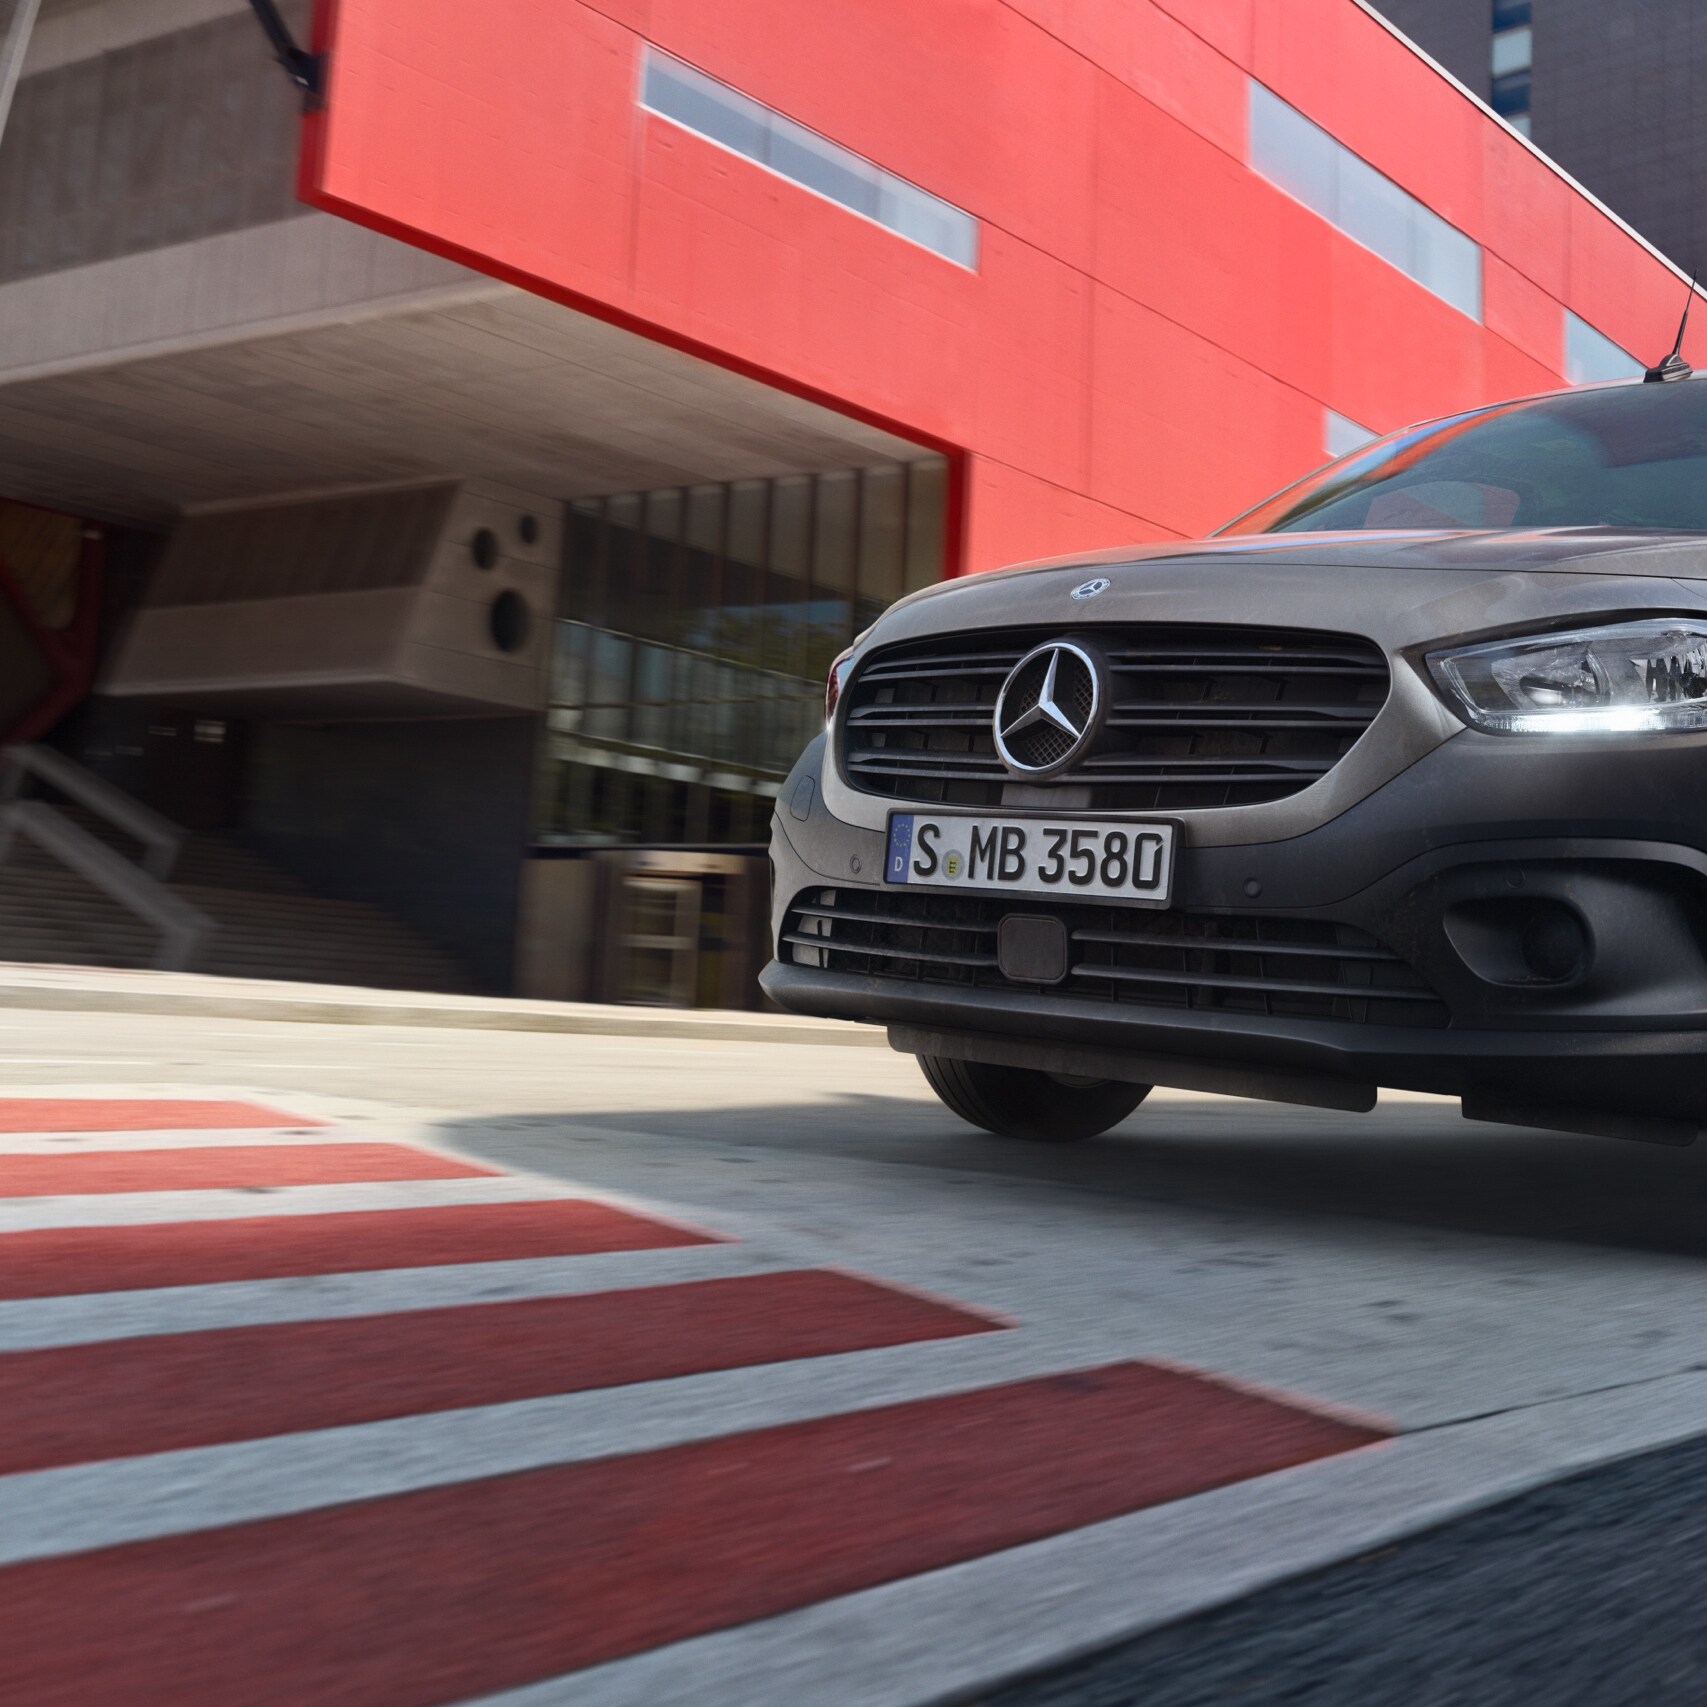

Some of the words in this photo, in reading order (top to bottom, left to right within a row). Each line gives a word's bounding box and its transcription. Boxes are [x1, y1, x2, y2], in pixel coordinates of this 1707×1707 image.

[894, 856, 903, 872] D
[913, 823, 940, 877] S
[967, 825, 1026, 882] MB
[1038, 828, 1163, 890] 3580
